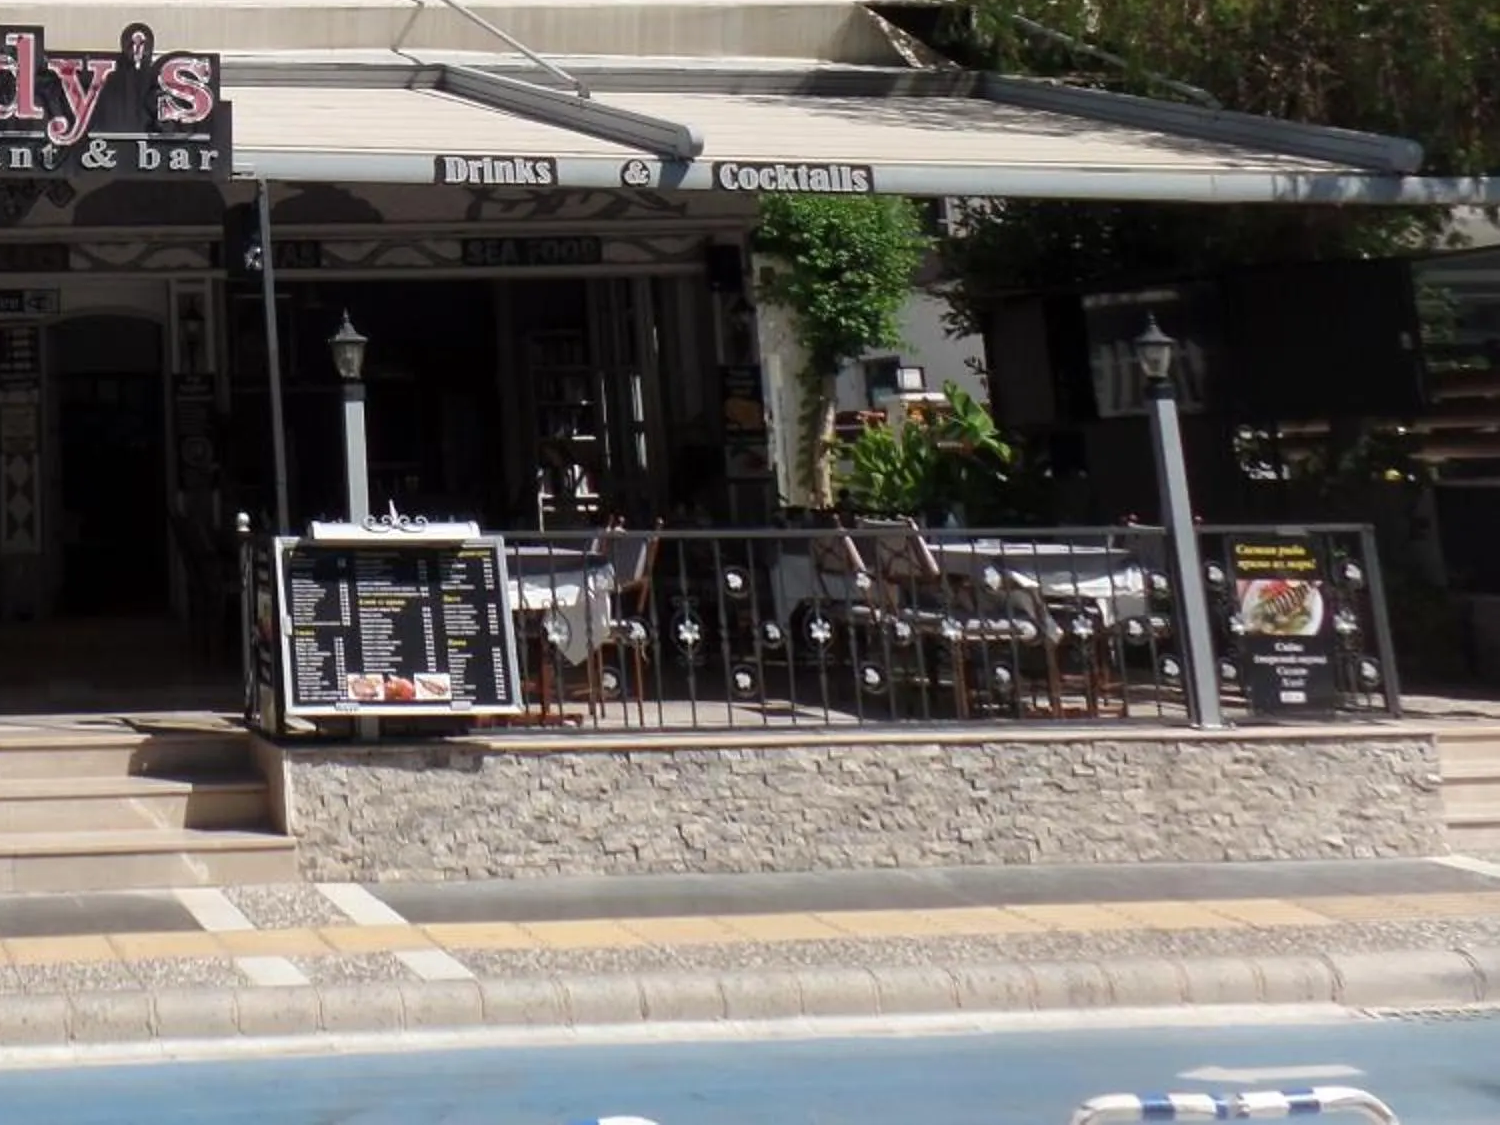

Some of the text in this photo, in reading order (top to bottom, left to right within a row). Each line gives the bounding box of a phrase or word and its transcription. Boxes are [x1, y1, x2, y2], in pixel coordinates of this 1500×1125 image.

[81, 140, 118, 170] &
[137, 140, 220, 171] bar
[443, 156, 871, 193] Drinks & Cocktails
[467, 237, 598, 265] SEA FOOD
